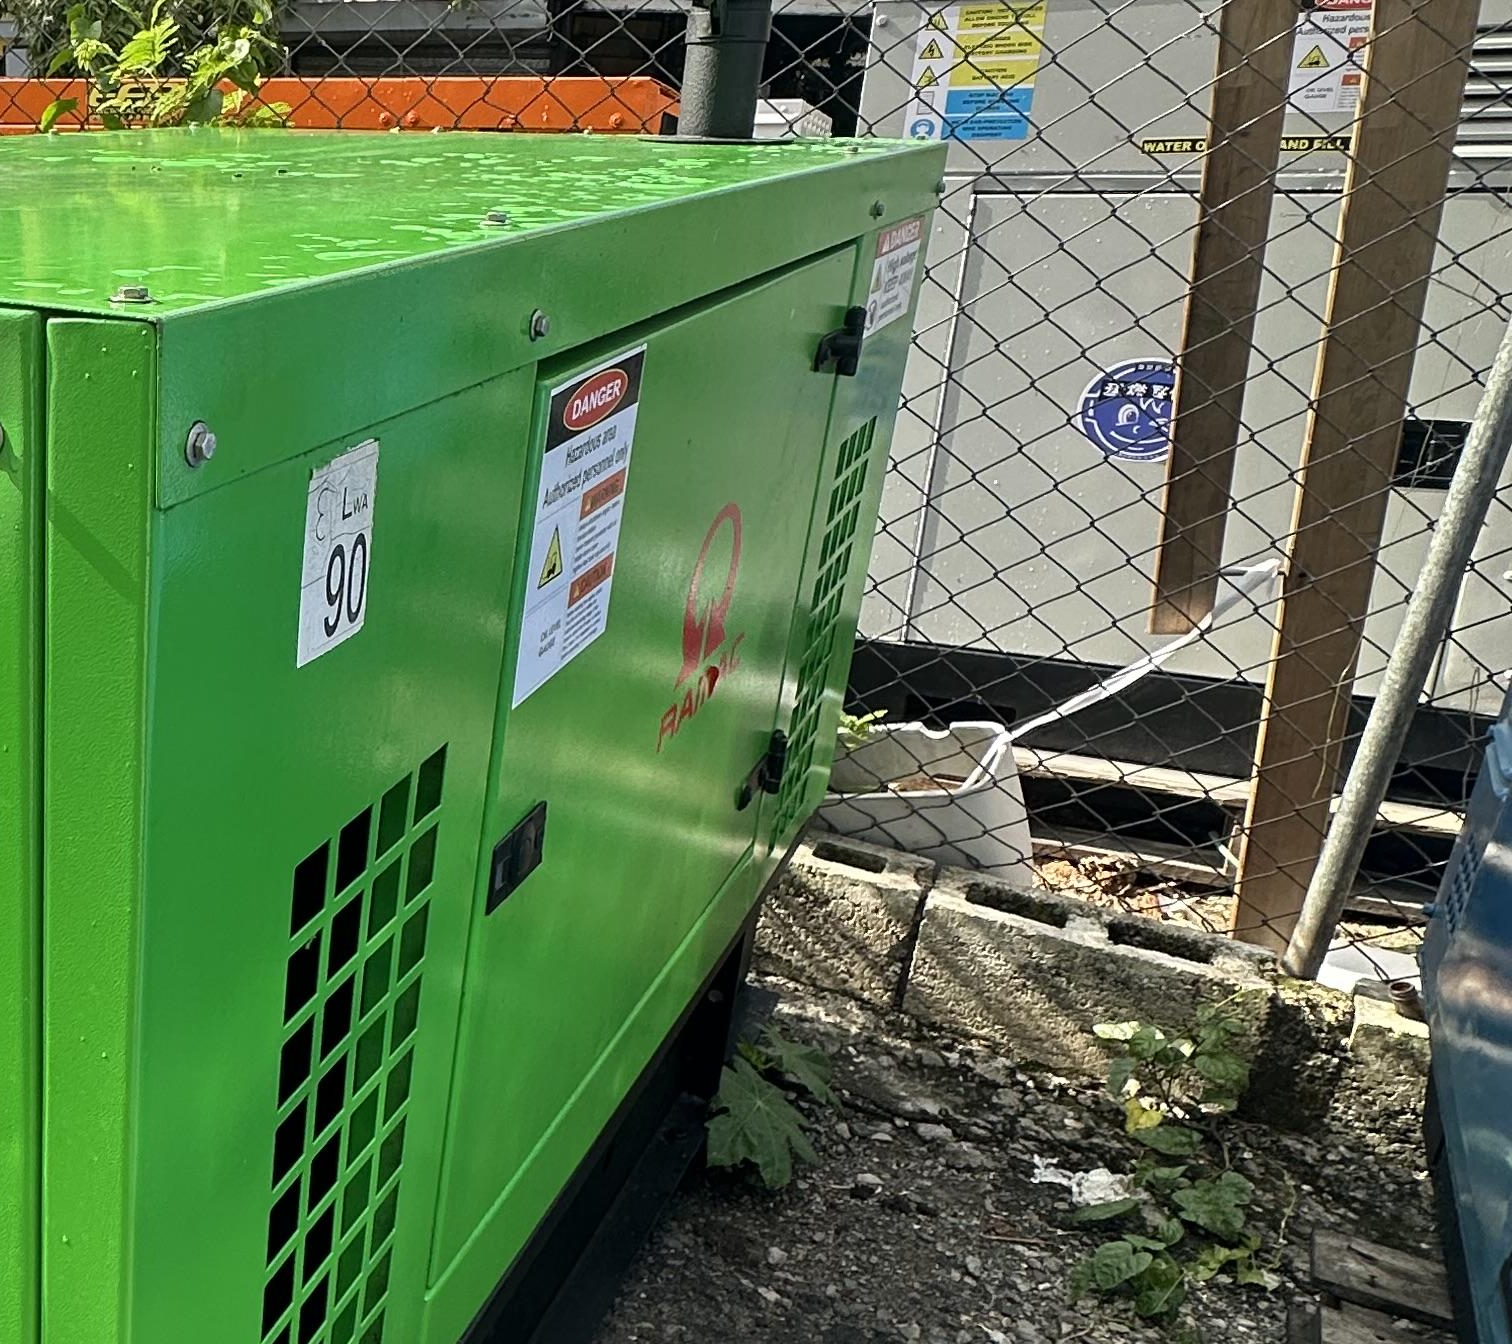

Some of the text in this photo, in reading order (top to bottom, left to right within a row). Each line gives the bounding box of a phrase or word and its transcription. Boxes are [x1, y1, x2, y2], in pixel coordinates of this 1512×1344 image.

[1143, 140, 1191, 153] WATER
[571, 378, 622, 420] DANGER
[323, 532, 368, 638] 90
